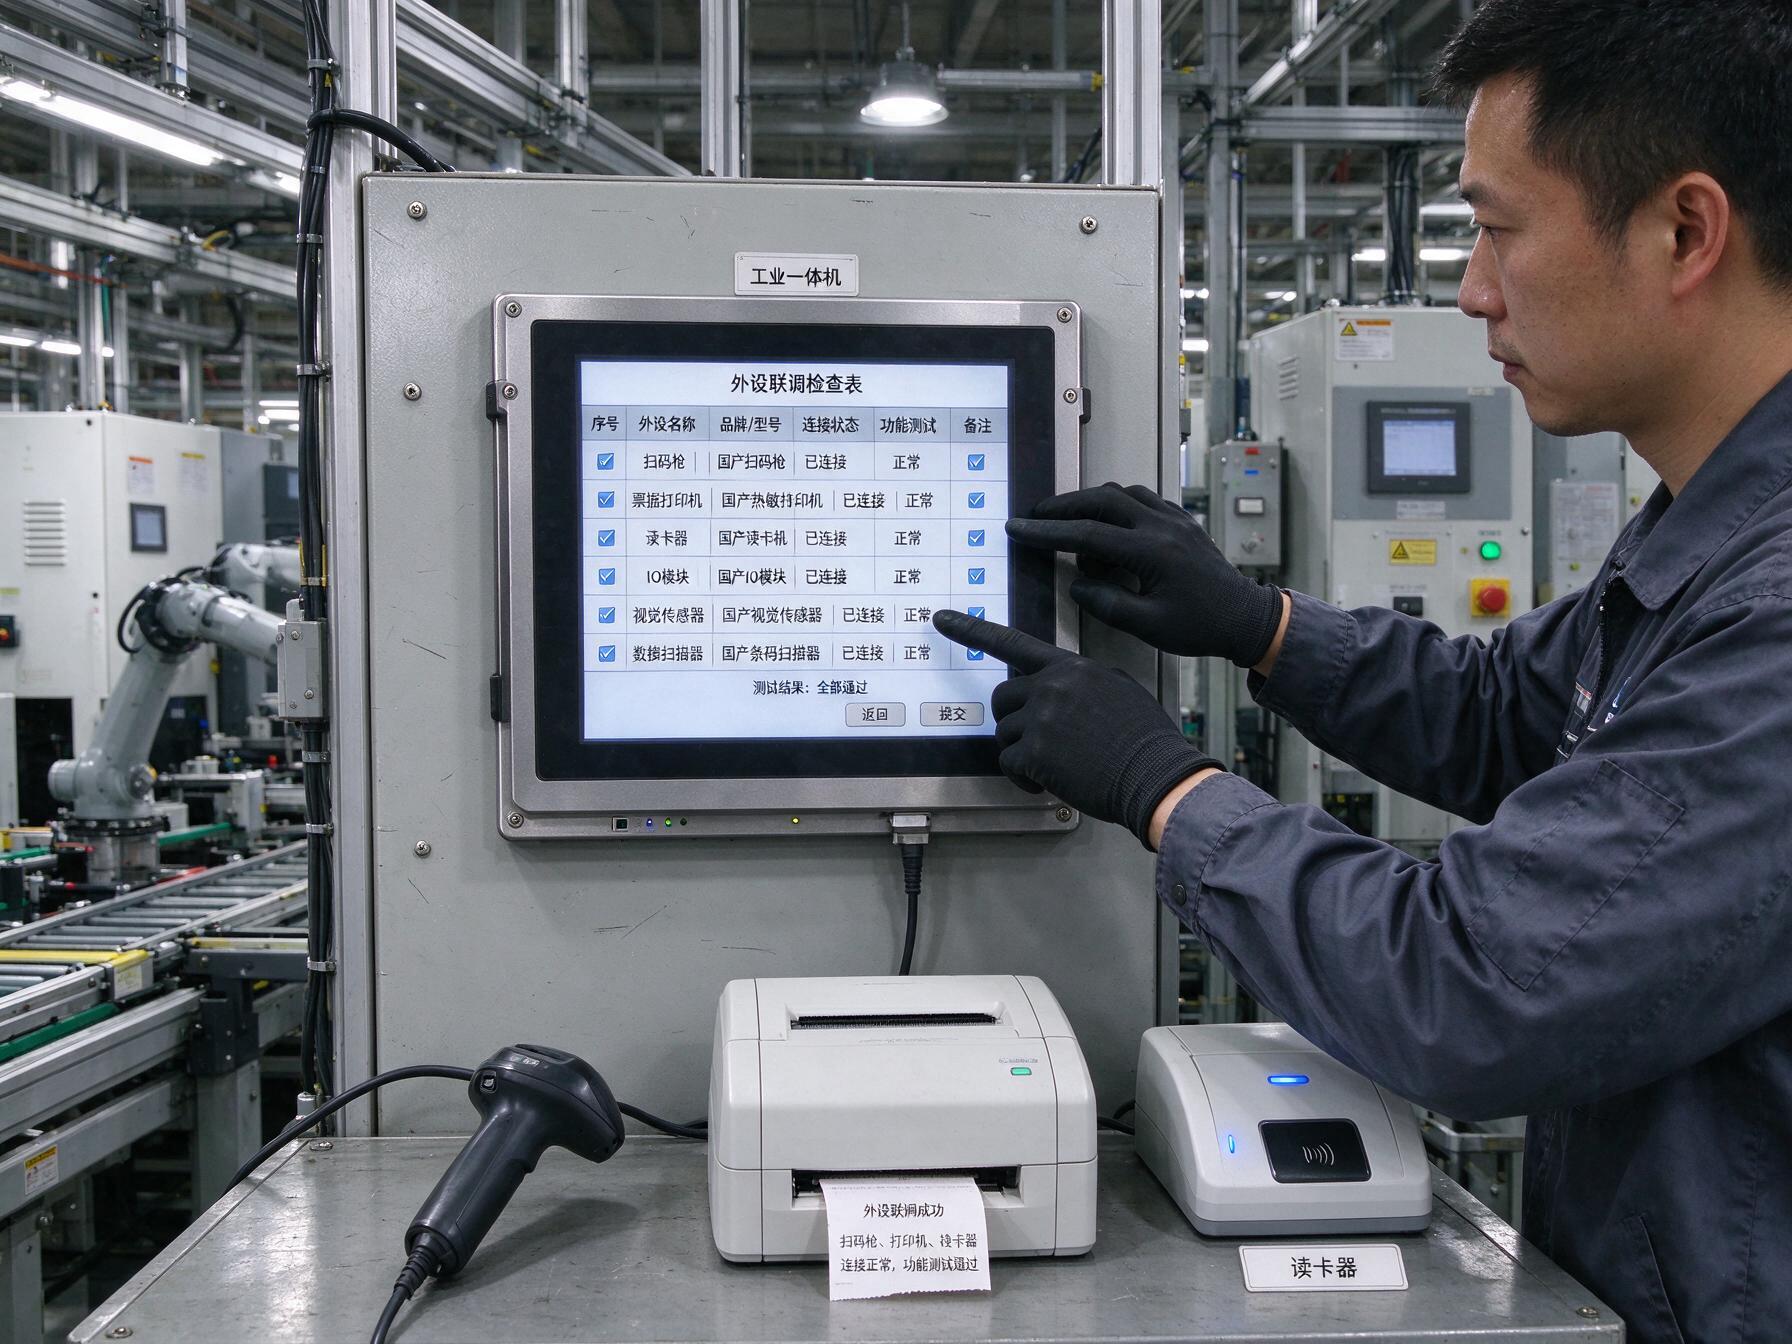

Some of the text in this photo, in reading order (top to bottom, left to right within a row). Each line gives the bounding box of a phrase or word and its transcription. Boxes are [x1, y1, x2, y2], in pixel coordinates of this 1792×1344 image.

[750, 267, 841, 286] 工业一体机
[731, 373, 862, 394] 外设联调检查表
[591, 416, 992, 434] 序号 外设名称 品牌/型号 连接状态 功能测试 备注
[644, 453, 920, 470] 扫码枪 国产扫码枪 已连接 正常
[844, 492, 884, 508] 已连接
[905, 493, 933, 507] 正常
[806, 531, 847, 546] 已连接
[894, 530, 921, 545] 正常
[806, 568, 846, 584] 已连接
[894, 569, 921, 583] 正常
[633, 607, 931, 624] 视觉传感器 国产视觉传感器 已连接 正常
[843, 644, 883, 661] 已连接
[904, 644, 931, 660] 正常
[862, 708, 887, 721] 返回
[1291, 1257, 1357, 1279] 读卡器
